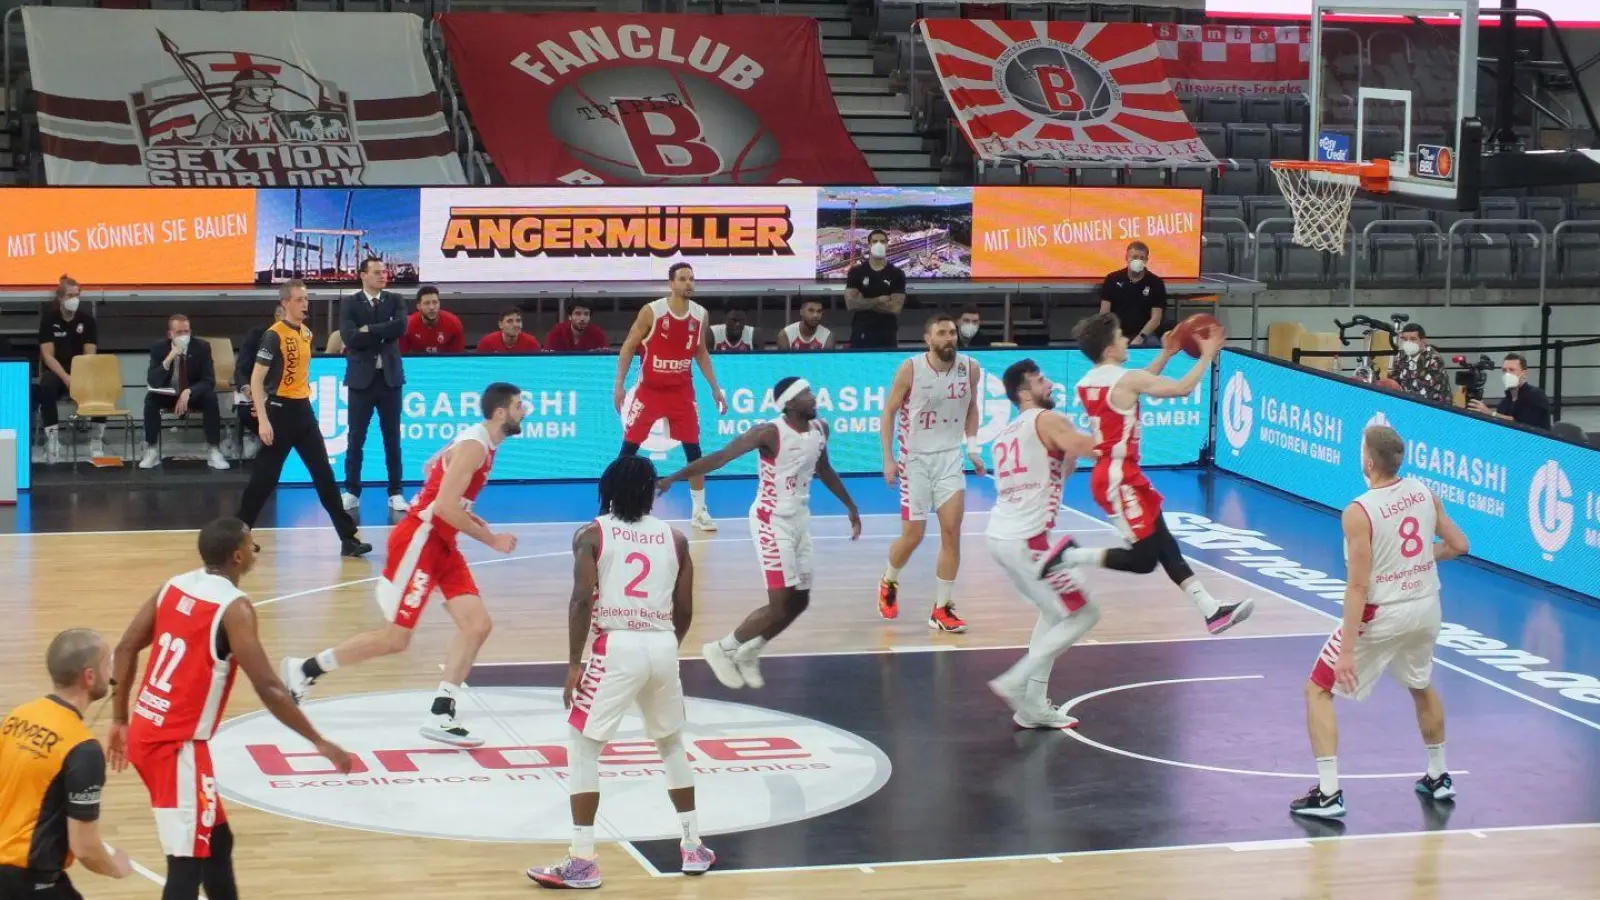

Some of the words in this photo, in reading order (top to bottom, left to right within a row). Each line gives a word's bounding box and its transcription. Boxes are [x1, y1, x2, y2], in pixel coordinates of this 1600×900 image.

[1159, 25, 1312, 40] Bamber
[510, 24, 765, 91] FANCLUB
[576, 92, 683, 121] TRIPLE
[1032, 64, 1086, 112] B
[609, 96, 723, 177] B
[146, 145, 363, 171] SEKTION
[7, 233, 37, 258] MIT
[44, 230, 80, 255] UNS
[87, 221, 155, 250] KÖNNEN
[162, 218, 187, 243] SIE
[194, 212, 248, 240] BAUEN
[441, 205, 795, 258] ANGERMÜLLER
[984, 229, 1010, 252] MIT
[1016, 225, 1048, 248] UNS
[1053, 219, 1113, 245] KÖNNEN
[1118, 216, 1141, 239] SIE
[1147, 211, 1193, 237] BAUEN
[402, 390, 577, 418] GARSHI
[947, 382, 967, 399] 13
[834, 416, 882, 434] GMB
[1260, 396, 1342, 445] IGARASHI
[993, 437, 1028, 478] 21
[1260, 426, 1308, 455] MOTOREN
[1310, 442, 1341, 465] GMBH
[1407, 439, 1507, 493] IGARASHI
[1379, 491, 1426, 519] Lischka
[1467, 491, 1505, 518] GMBH
[611, 526, 665, 545] Pollard
[1399, 516, 1423, 558] 8
[624, 551, 651, 599] 2
[3, 716, 60, 753] GYMPER
[245, 737, 812, 776] brose
[269, 774, 491, 790] Excellence
[506, 771, 541, 782] in
